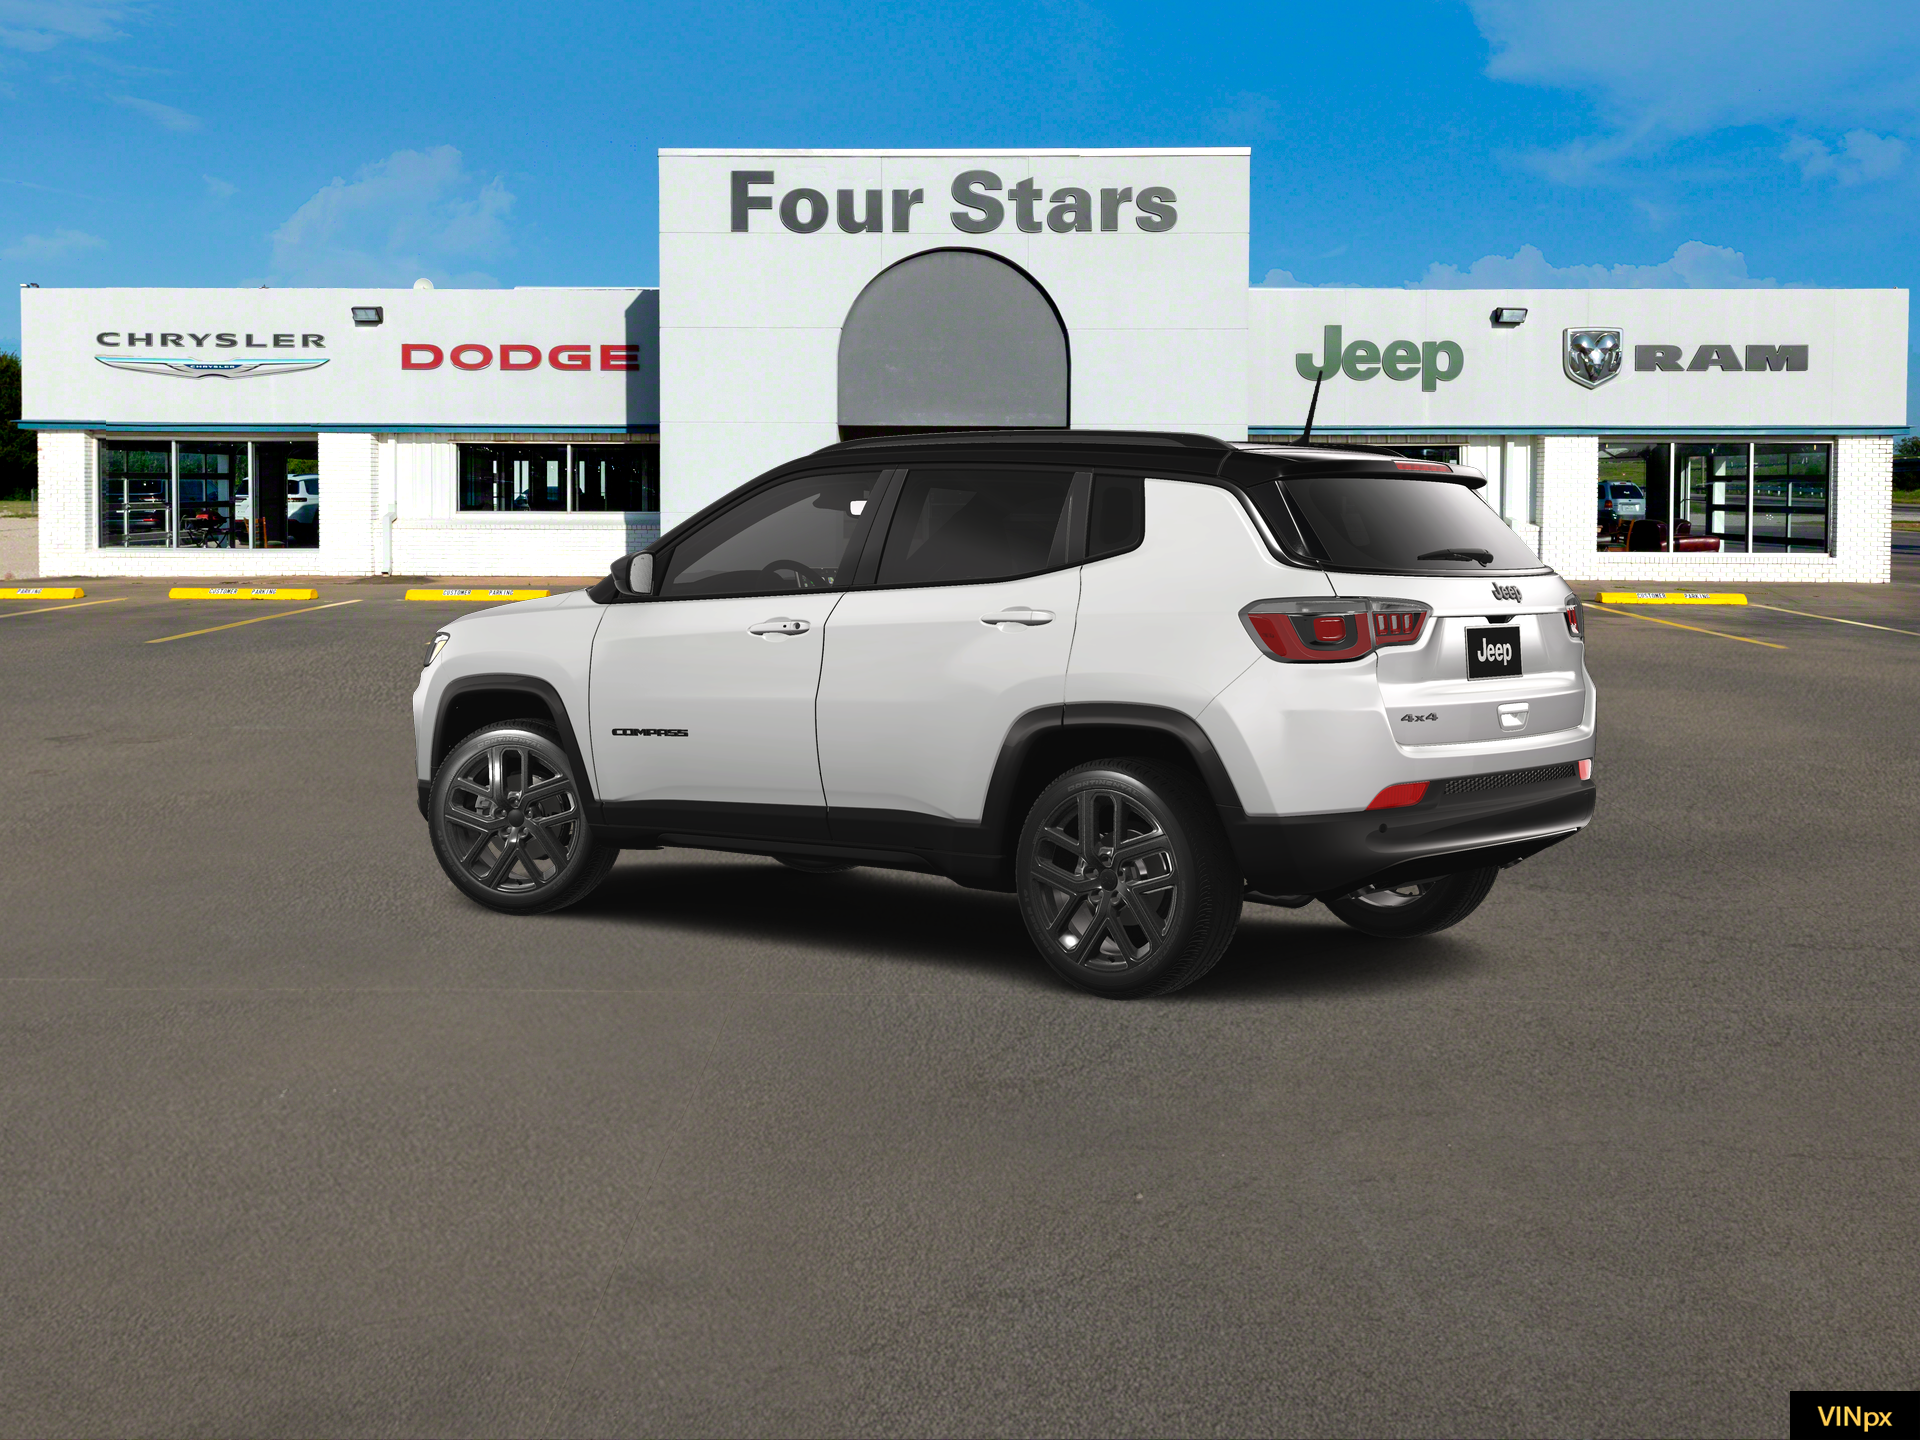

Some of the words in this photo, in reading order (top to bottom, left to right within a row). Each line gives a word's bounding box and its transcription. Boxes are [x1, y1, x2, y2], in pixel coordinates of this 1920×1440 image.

[730, 170, 924, 234] Four
[950, 169, 1178, 234] Stars
[96, 331, 326, 349] CHRYSLER
[401, 343, 640, 371] DODGE
[1296, 324, 1464, 392] Jeep
[1634, 344, 1809, 372] RAM
[1491, 581, 1522, 604] Jeep
[1477, 637, 1512, 666] Jeep
[1400, 712, 1439, 723] 4x4
[612, 728, 689, 737] COMPASS
[1067, 779, 1139, 797] CONTINENTAL
